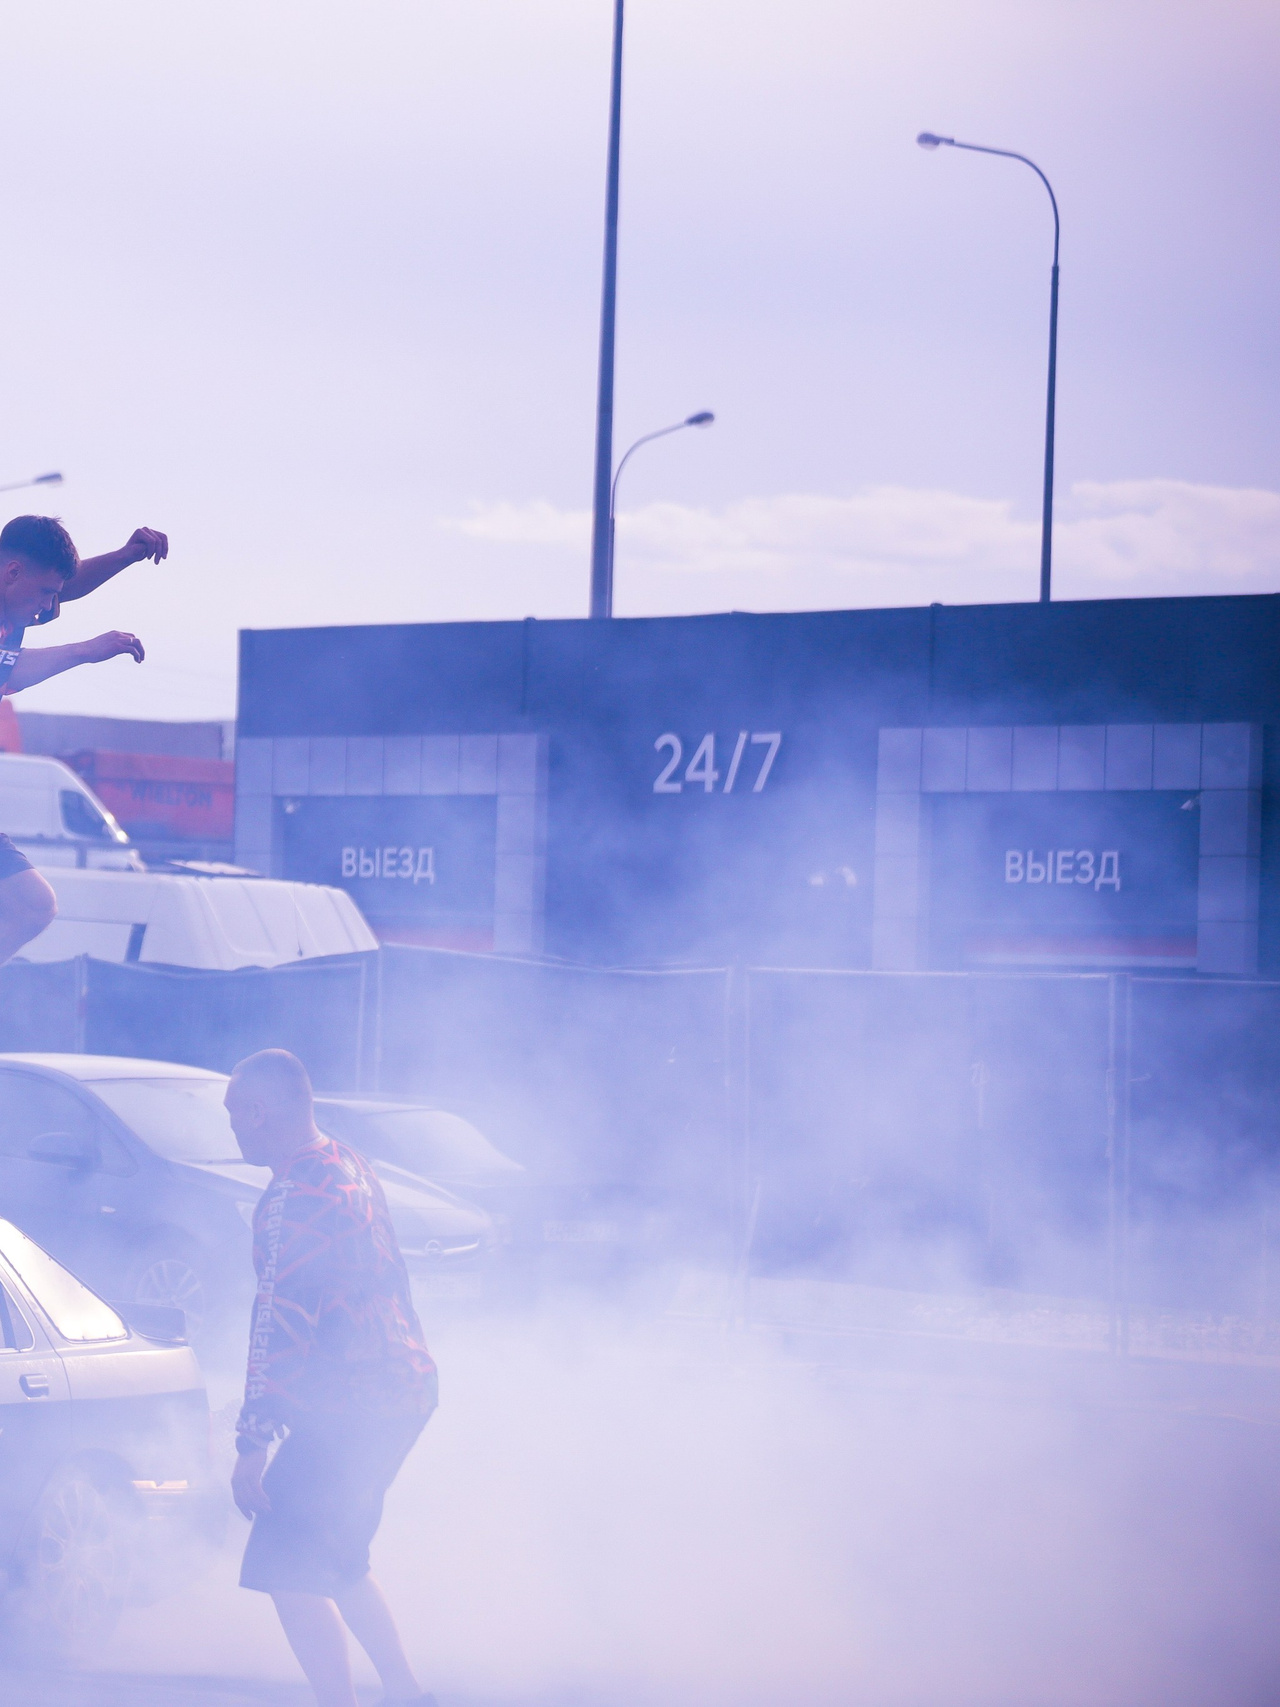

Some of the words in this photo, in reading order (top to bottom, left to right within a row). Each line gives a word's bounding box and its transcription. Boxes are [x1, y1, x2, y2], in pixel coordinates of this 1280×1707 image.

[653, 730, 782, 794] 24/7
[341, 847, 435, 884] ВЫЕЗД
[1005, 850, 1121, 892] ВЫЕЗД
